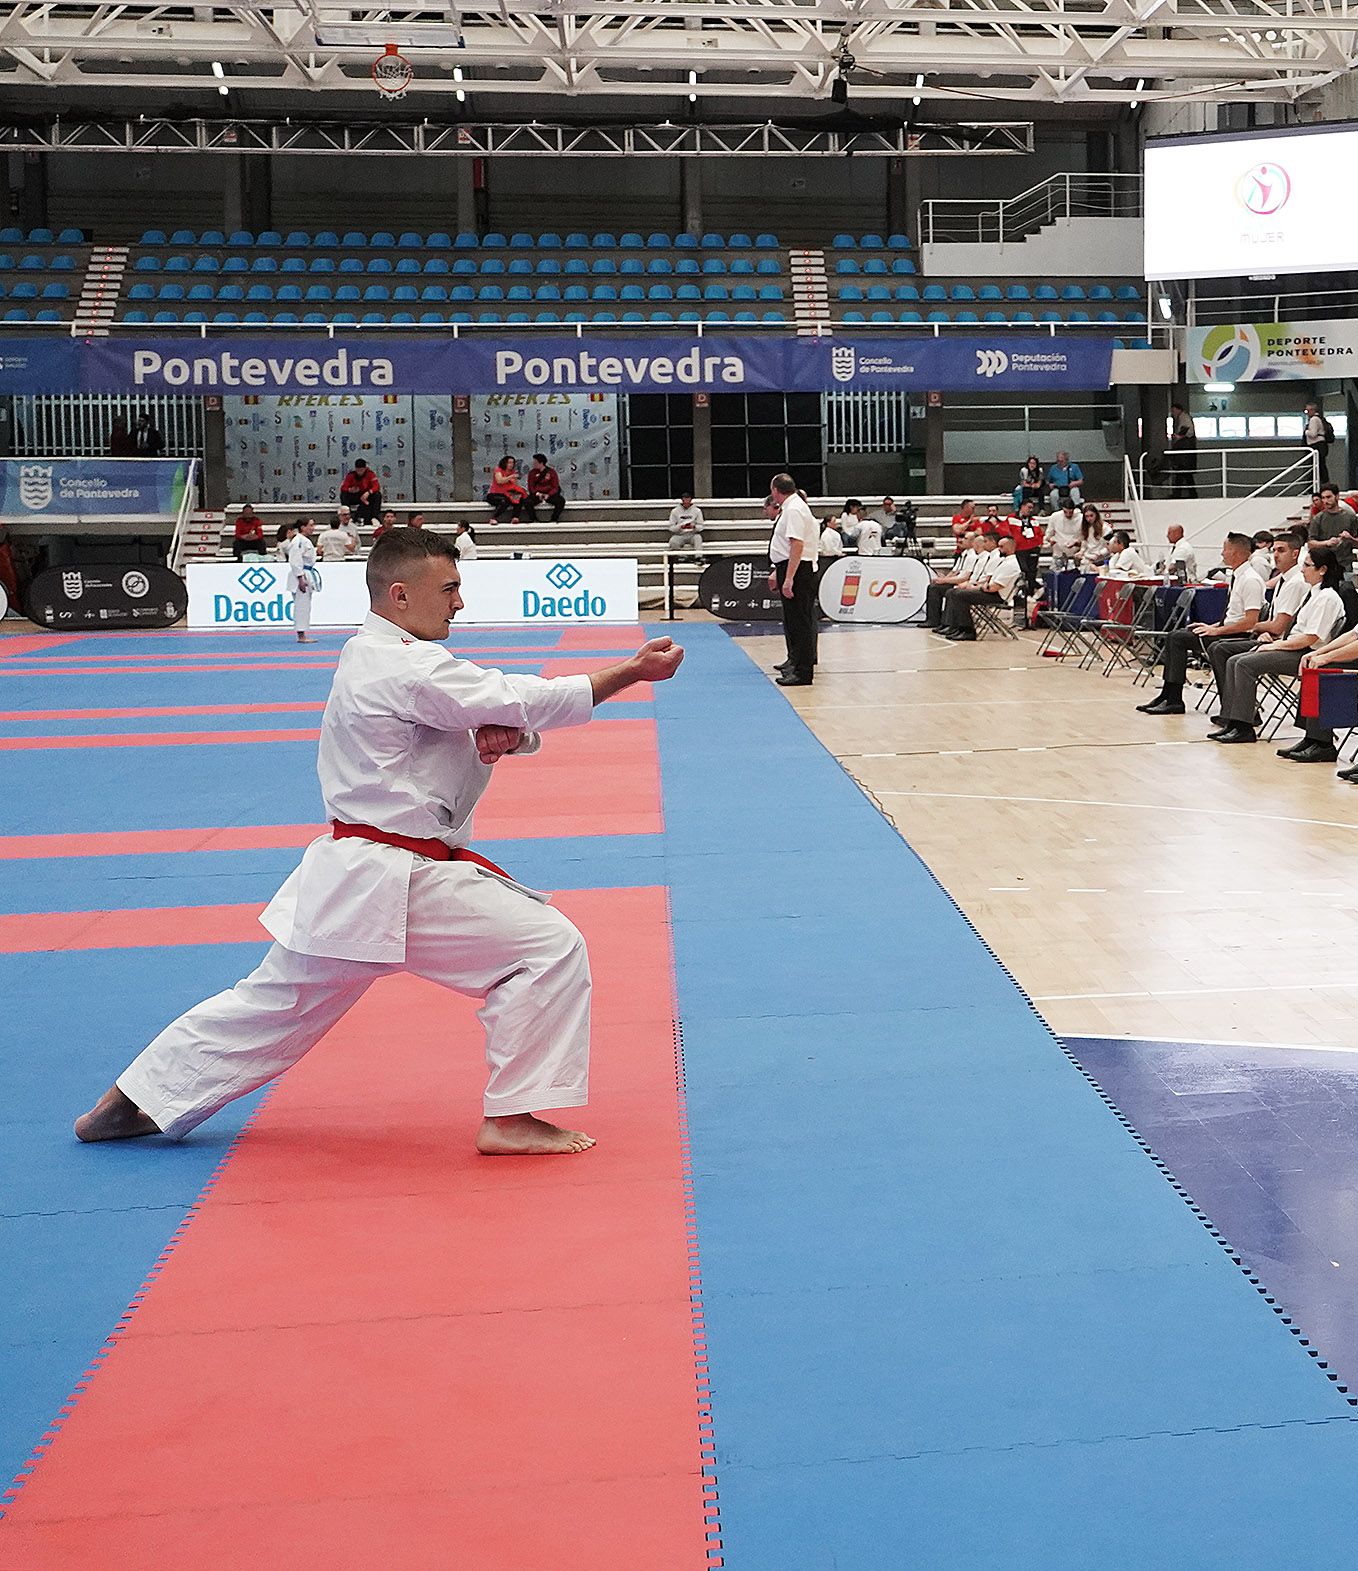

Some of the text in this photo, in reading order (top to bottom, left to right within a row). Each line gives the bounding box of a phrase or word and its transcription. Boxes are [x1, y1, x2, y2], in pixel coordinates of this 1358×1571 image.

[1267, 336, 1326, 346] DEPORTE
[1012, 352, 1068, 364] Deputación
[1267, 348, 1354, 358] PONTEVEDRA
[496, 346, 744, 386] Pontevedra
[858, 356, 893, 366] Concello
[134, 348, 394, 386] Pontevedra
[859, 366, 914, 374] de Pontevedra
[1012, 362, 1068, 372] Pontevedra
[457, 400, 466, 408] D
[58, 477, 108, 488] Concello
[59, 488, 140, 498] de Pontevedra
[214, 594, 294, 622] Daedo
[522, 590, 606, 619] Daedo
